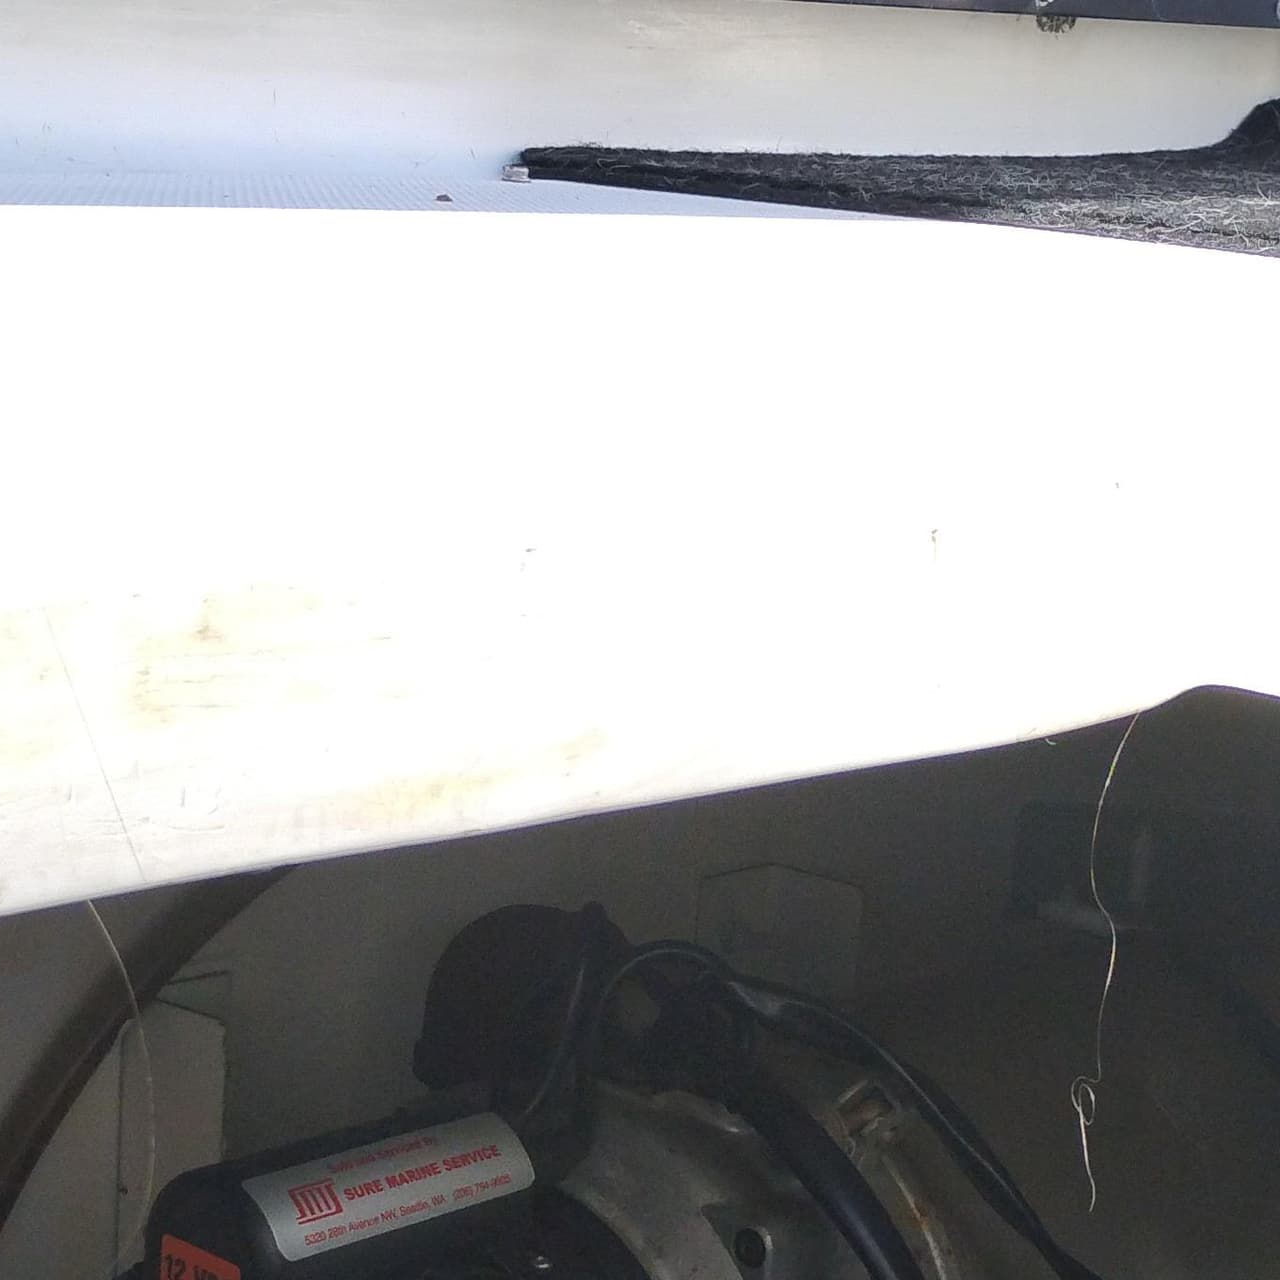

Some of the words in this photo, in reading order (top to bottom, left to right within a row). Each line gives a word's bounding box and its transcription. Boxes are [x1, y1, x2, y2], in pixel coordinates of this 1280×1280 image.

[343, 1179, 384, 1201] SURE
[384, 1162, 441, 1189] MARINE
[442, 1144, 501, 1171] SERVICE
